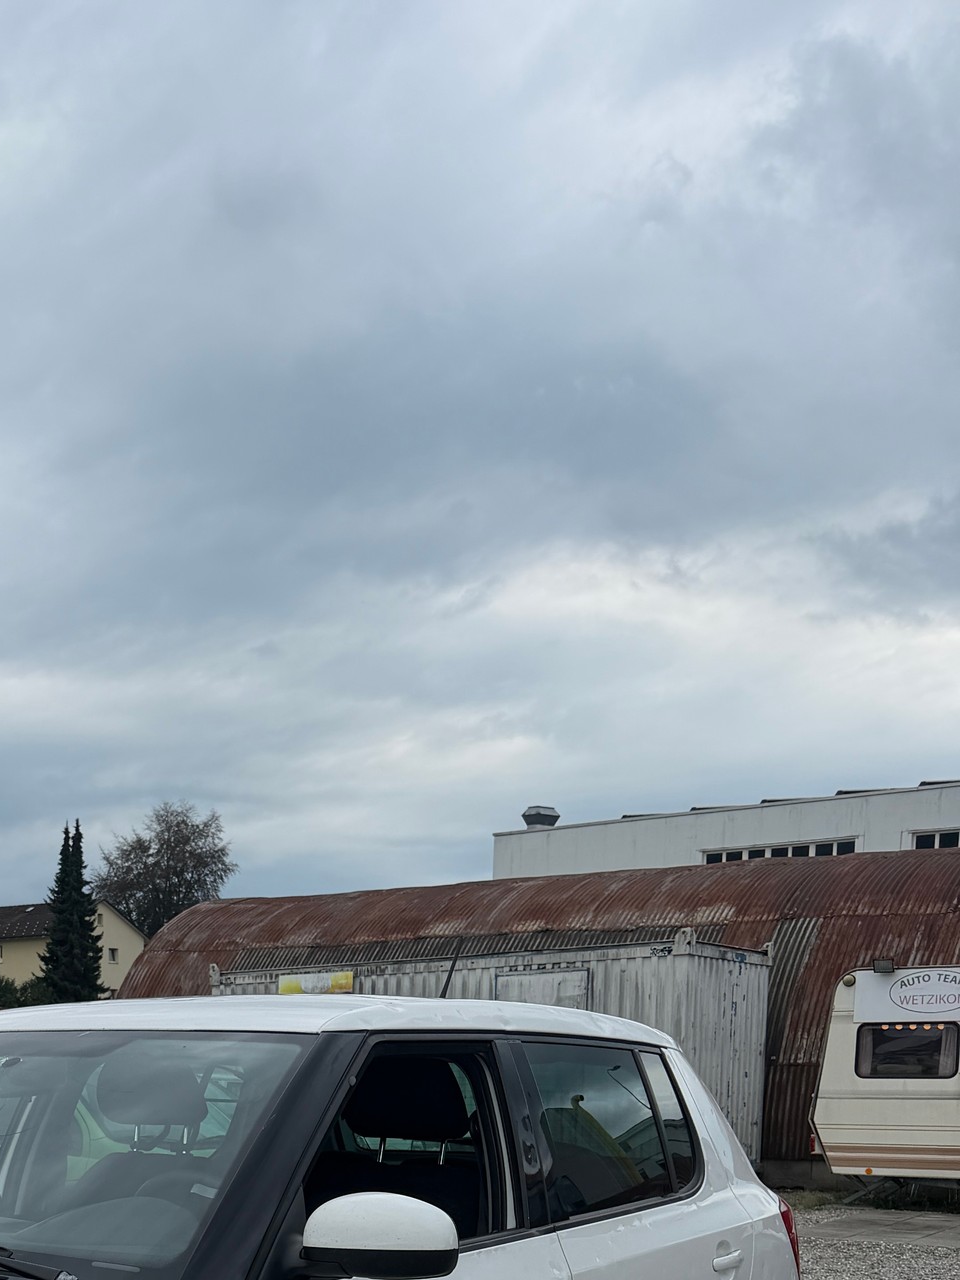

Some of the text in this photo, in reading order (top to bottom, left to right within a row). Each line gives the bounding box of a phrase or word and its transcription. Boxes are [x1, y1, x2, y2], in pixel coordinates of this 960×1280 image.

[900, 973, 960, 989] AUTO TEA
[899, 993, 960, 1006] WETZIKO
